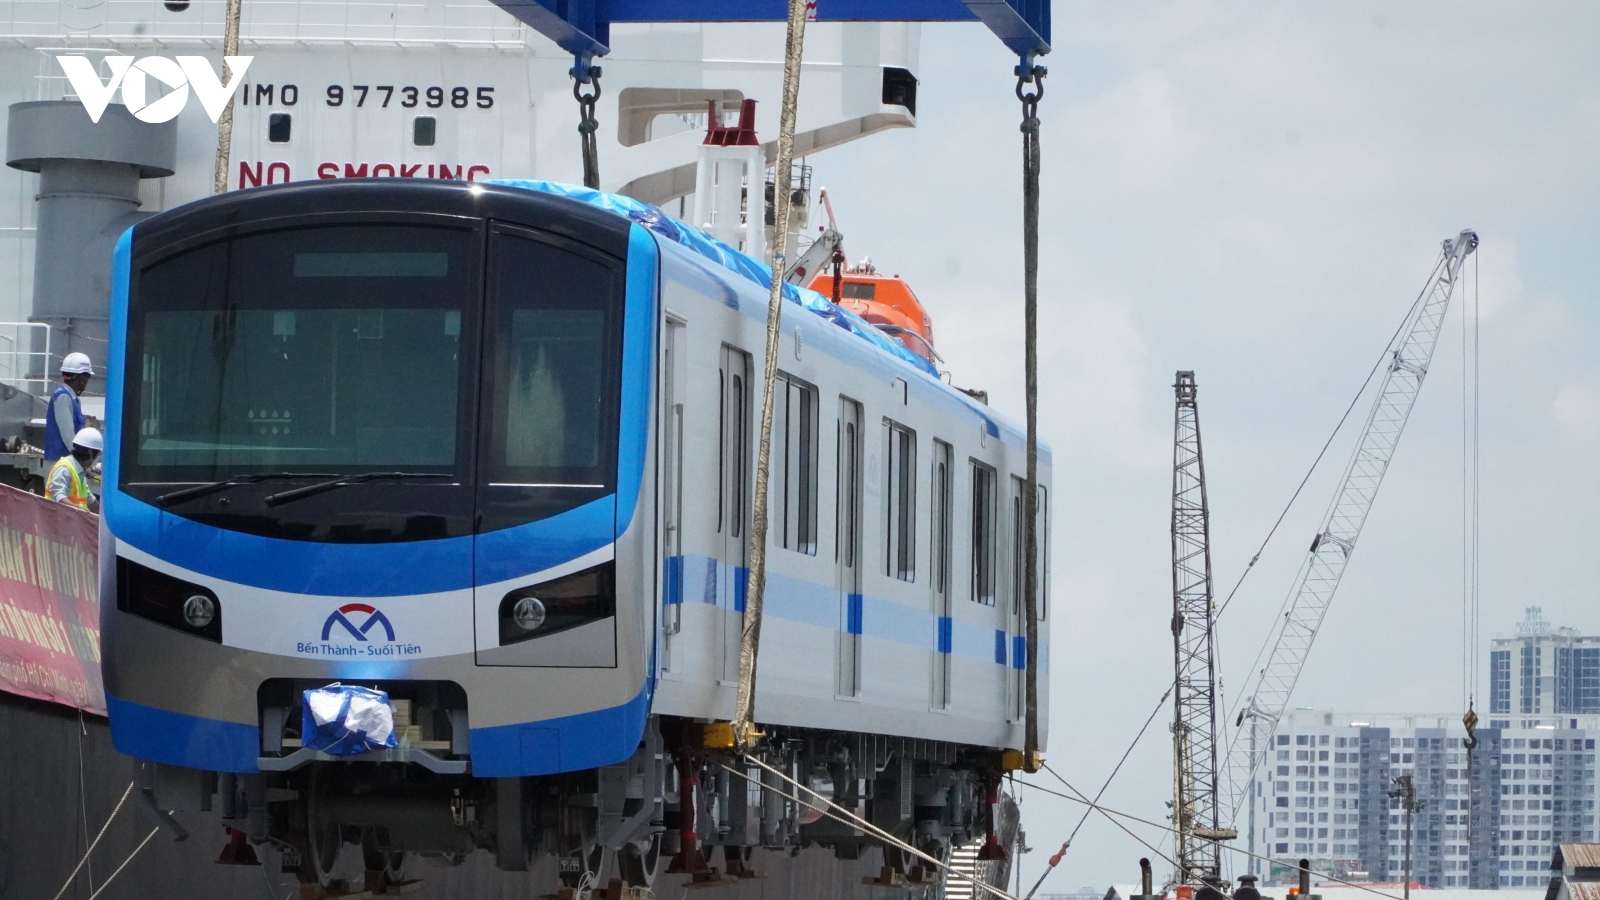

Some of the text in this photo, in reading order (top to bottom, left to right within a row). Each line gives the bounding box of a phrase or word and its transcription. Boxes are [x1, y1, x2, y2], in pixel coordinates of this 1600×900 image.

[243, 84, 494, 108] IMO 9773985
[239, 161, 290, 189] NO
[25, 523, 53, 591] TÀU
[52, 536, 79, 598] THỨ
[80, 550, 96, 604] 16
[41, 603, 66, 655] SỐ
[297, 642, 319, 654] Bến
[320, 644, 357, 656] Thành
[367, 644, 394, 656] Suối
[395, 644, 422, 654] Tiên
